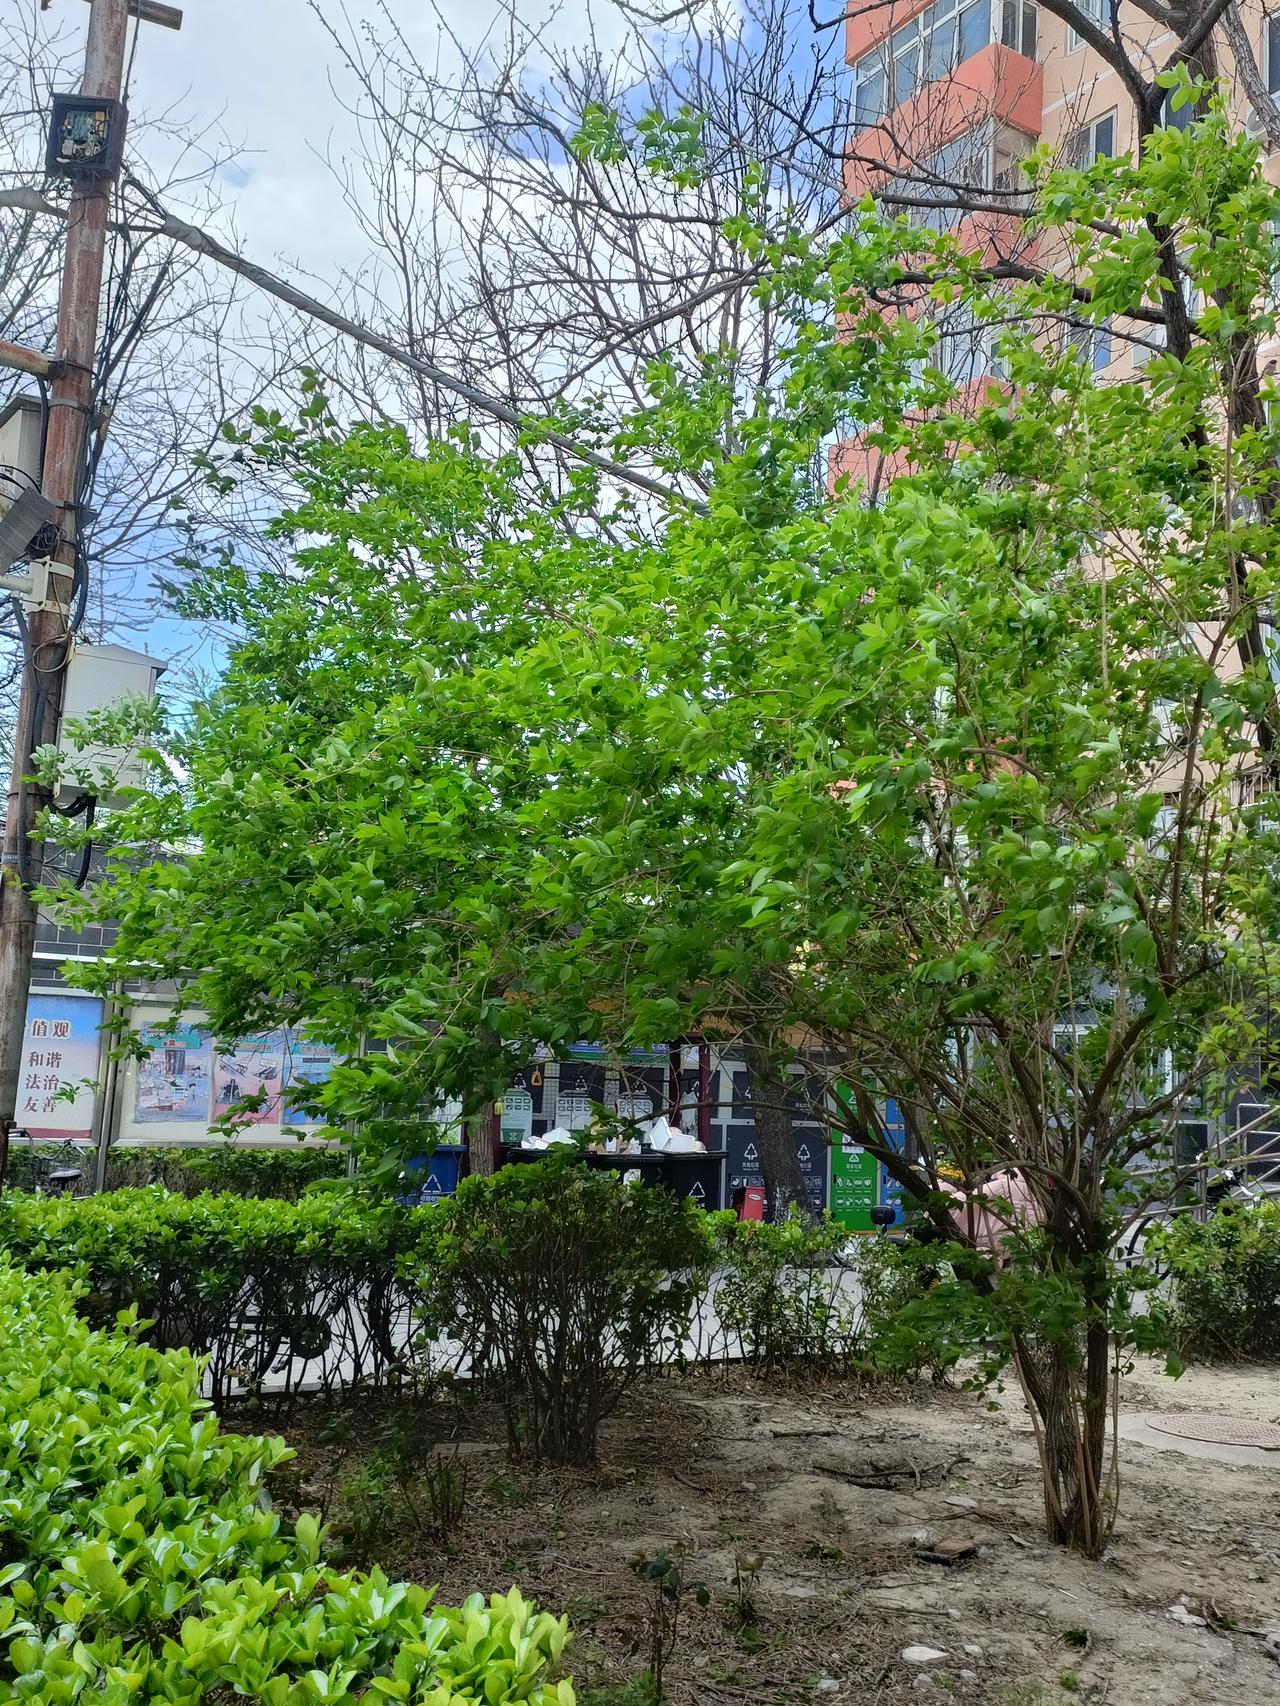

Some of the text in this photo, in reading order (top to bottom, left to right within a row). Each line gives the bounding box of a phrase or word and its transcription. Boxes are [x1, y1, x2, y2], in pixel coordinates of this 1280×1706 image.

[28, 1051, 62, 1068] 和谐
[25, 1073, 60, 1090] 法治
[23, 1096, 57, 1113] 友善
